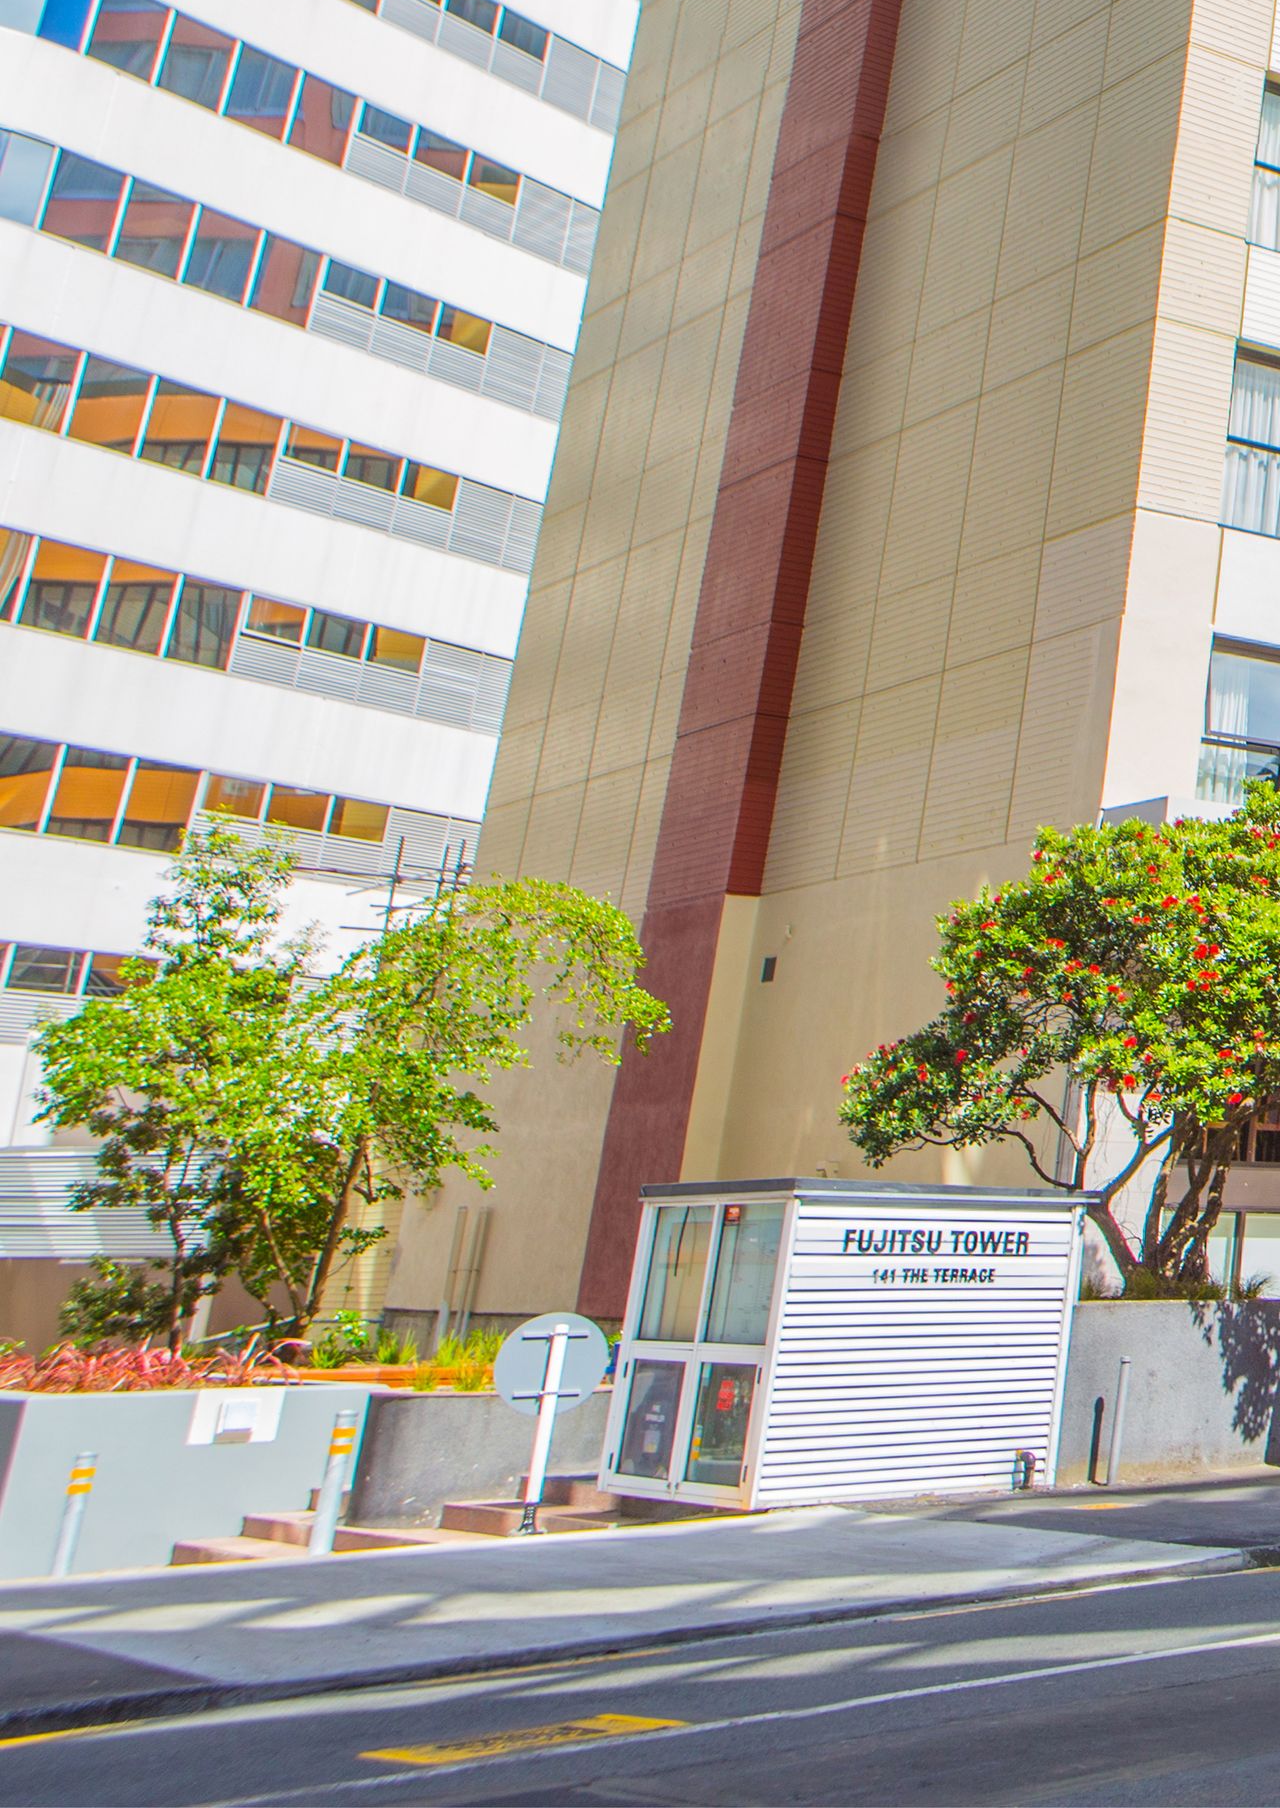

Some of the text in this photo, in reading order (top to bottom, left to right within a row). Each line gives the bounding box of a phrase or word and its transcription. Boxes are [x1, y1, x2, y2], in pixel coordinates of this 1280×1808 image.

[842, 1229, 1030, 1254] FUJITSU TOWER
[873, 1268, 996, 1284] 141 THE TERRACE
